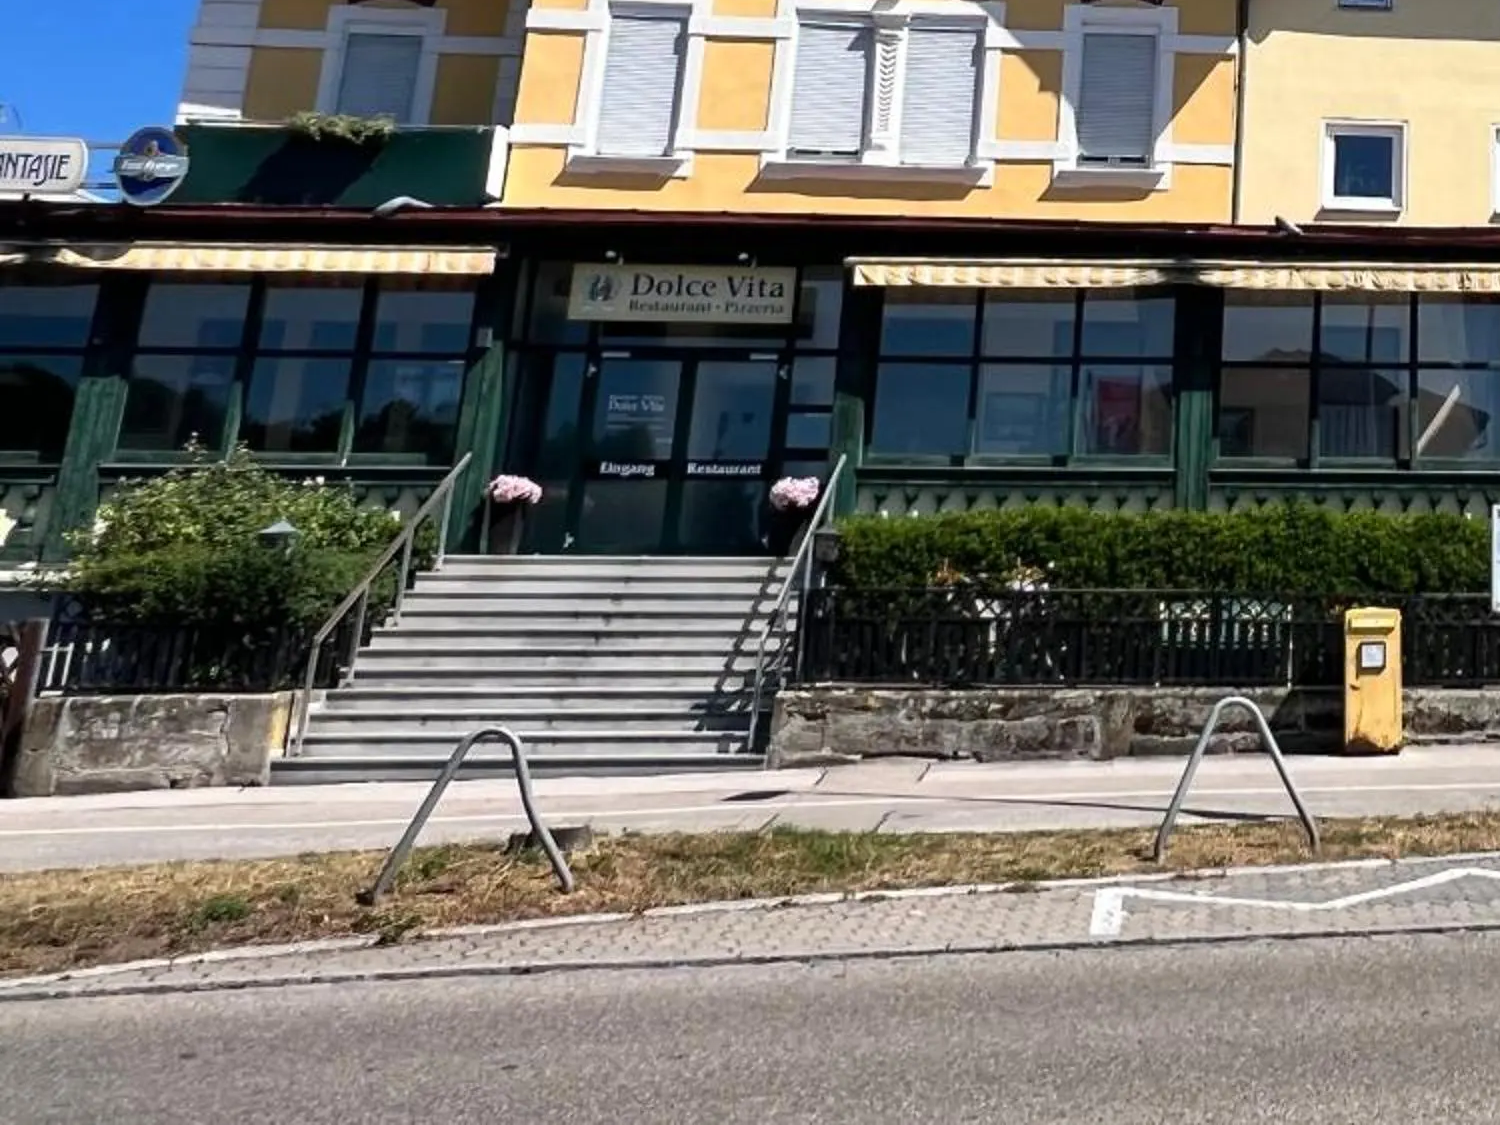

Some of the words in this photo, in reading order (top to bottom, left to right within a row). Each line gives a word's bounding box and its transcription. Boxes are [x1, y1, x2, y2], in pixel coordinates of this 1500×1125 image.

[631, 273, 717, 298] Dolce
[725, 275, 785, 299] Vita
[629, 299, 712, 314] Restaurant
[724, 301, 784, 315] Pizzeria
[599, 460, 656, 477] Eingang
[686, 462, 763, 476] Restaurant
